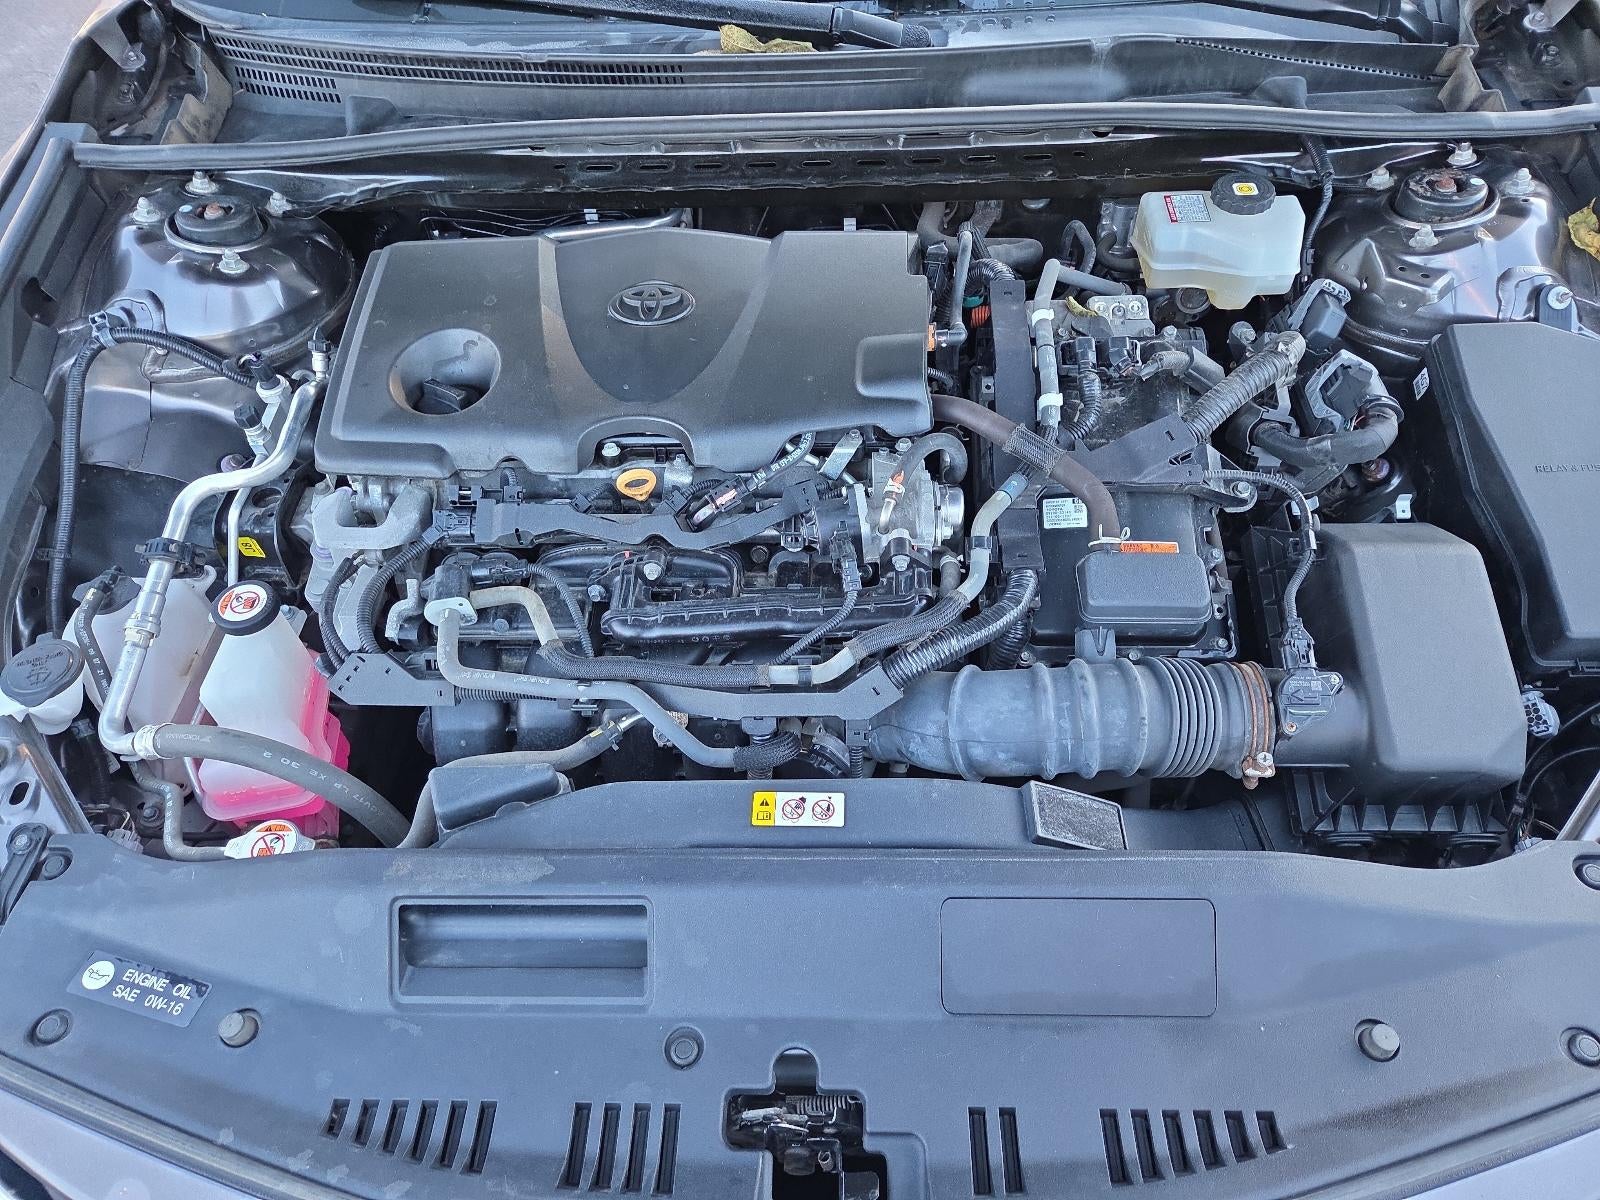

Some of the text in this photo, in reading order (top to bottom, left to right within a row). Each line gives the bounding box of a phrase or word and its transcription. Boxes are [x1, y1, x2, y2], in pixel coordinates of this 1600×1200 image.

[1535, 464, 1568, 473] RELAY
[112, 984, 184, 1016] SAE 0W-16
[122, 968, 193, 1000] ENGINE OIL
